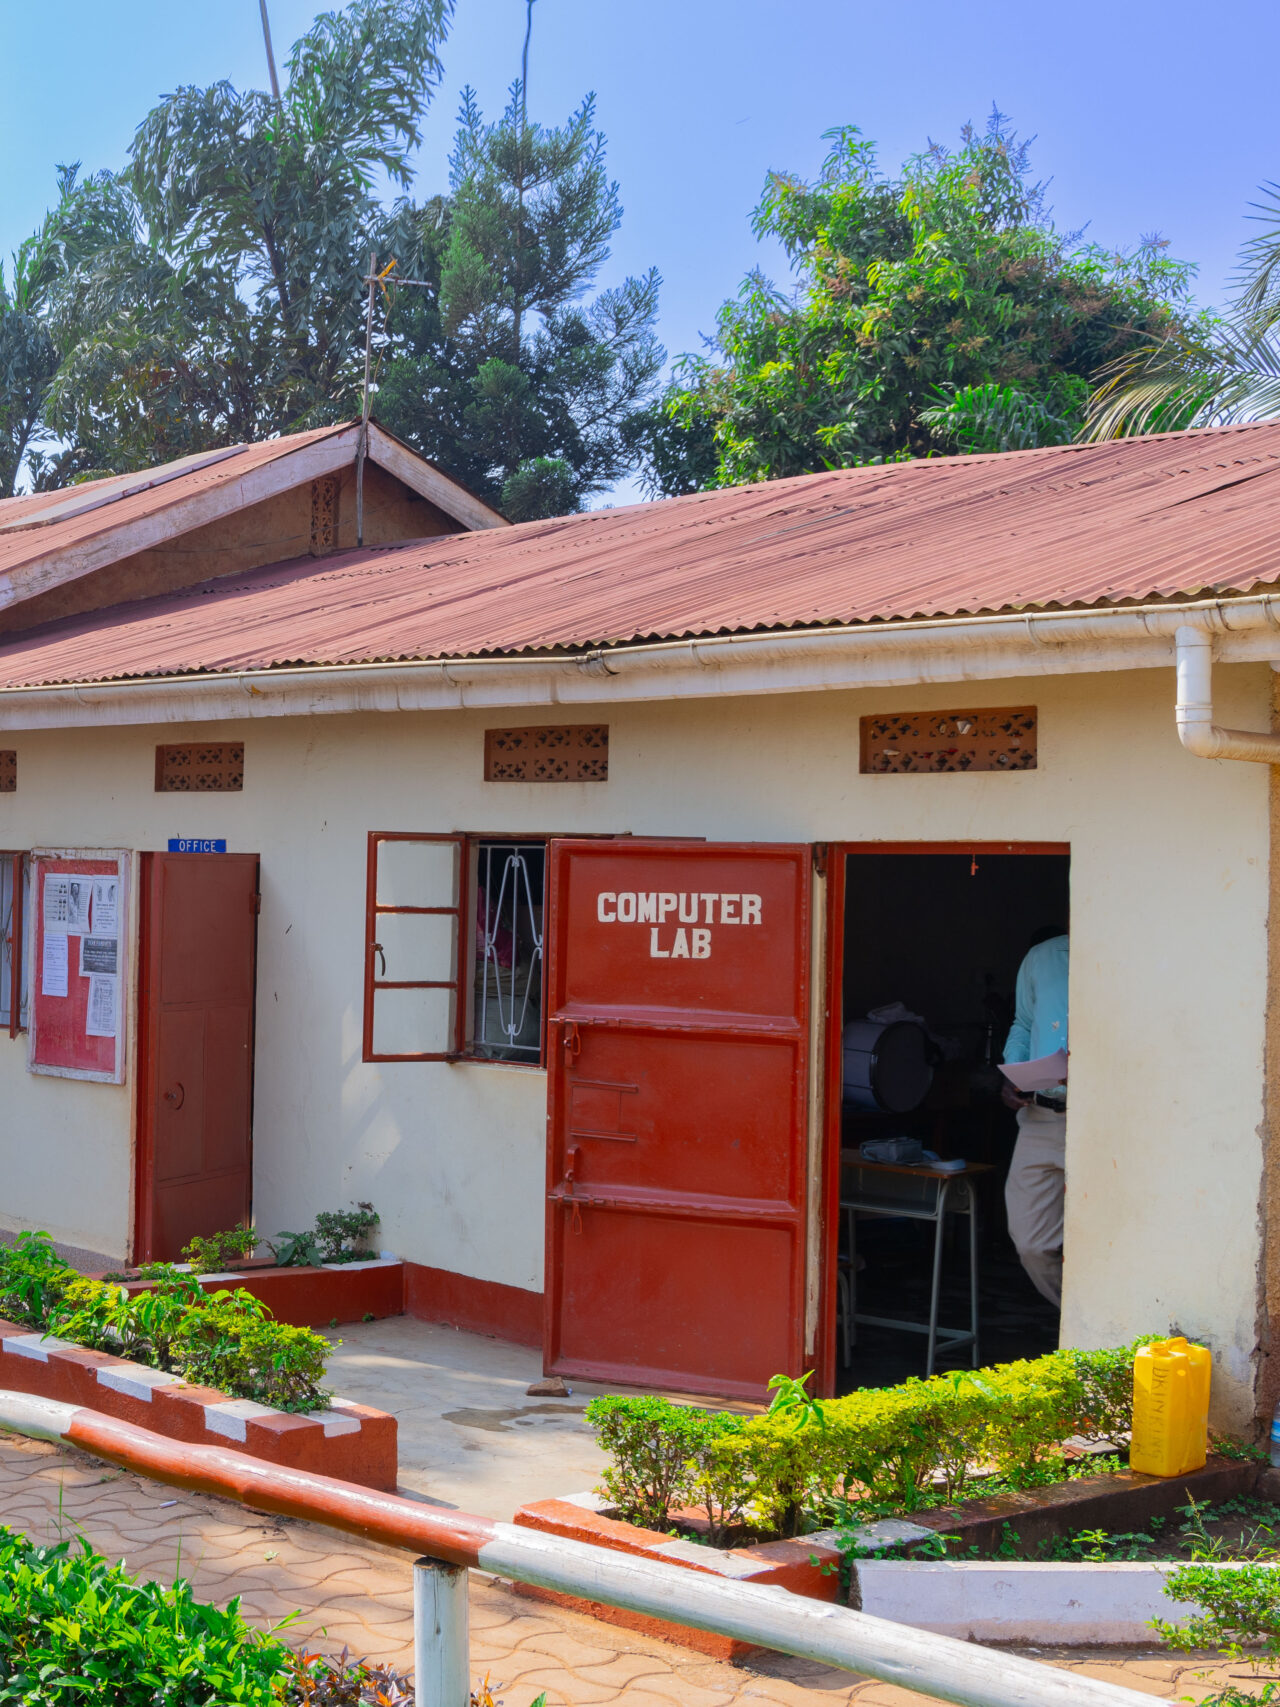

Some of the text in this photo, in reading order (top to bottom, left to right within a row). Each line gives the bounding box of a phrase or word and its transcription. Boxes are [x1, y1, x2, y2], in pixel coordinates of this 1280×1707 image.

[178, 840, 217, 852] OFFICE
[597, 892, 762, 925] COMPUTER
[650, 927, 712, 959] LAB
